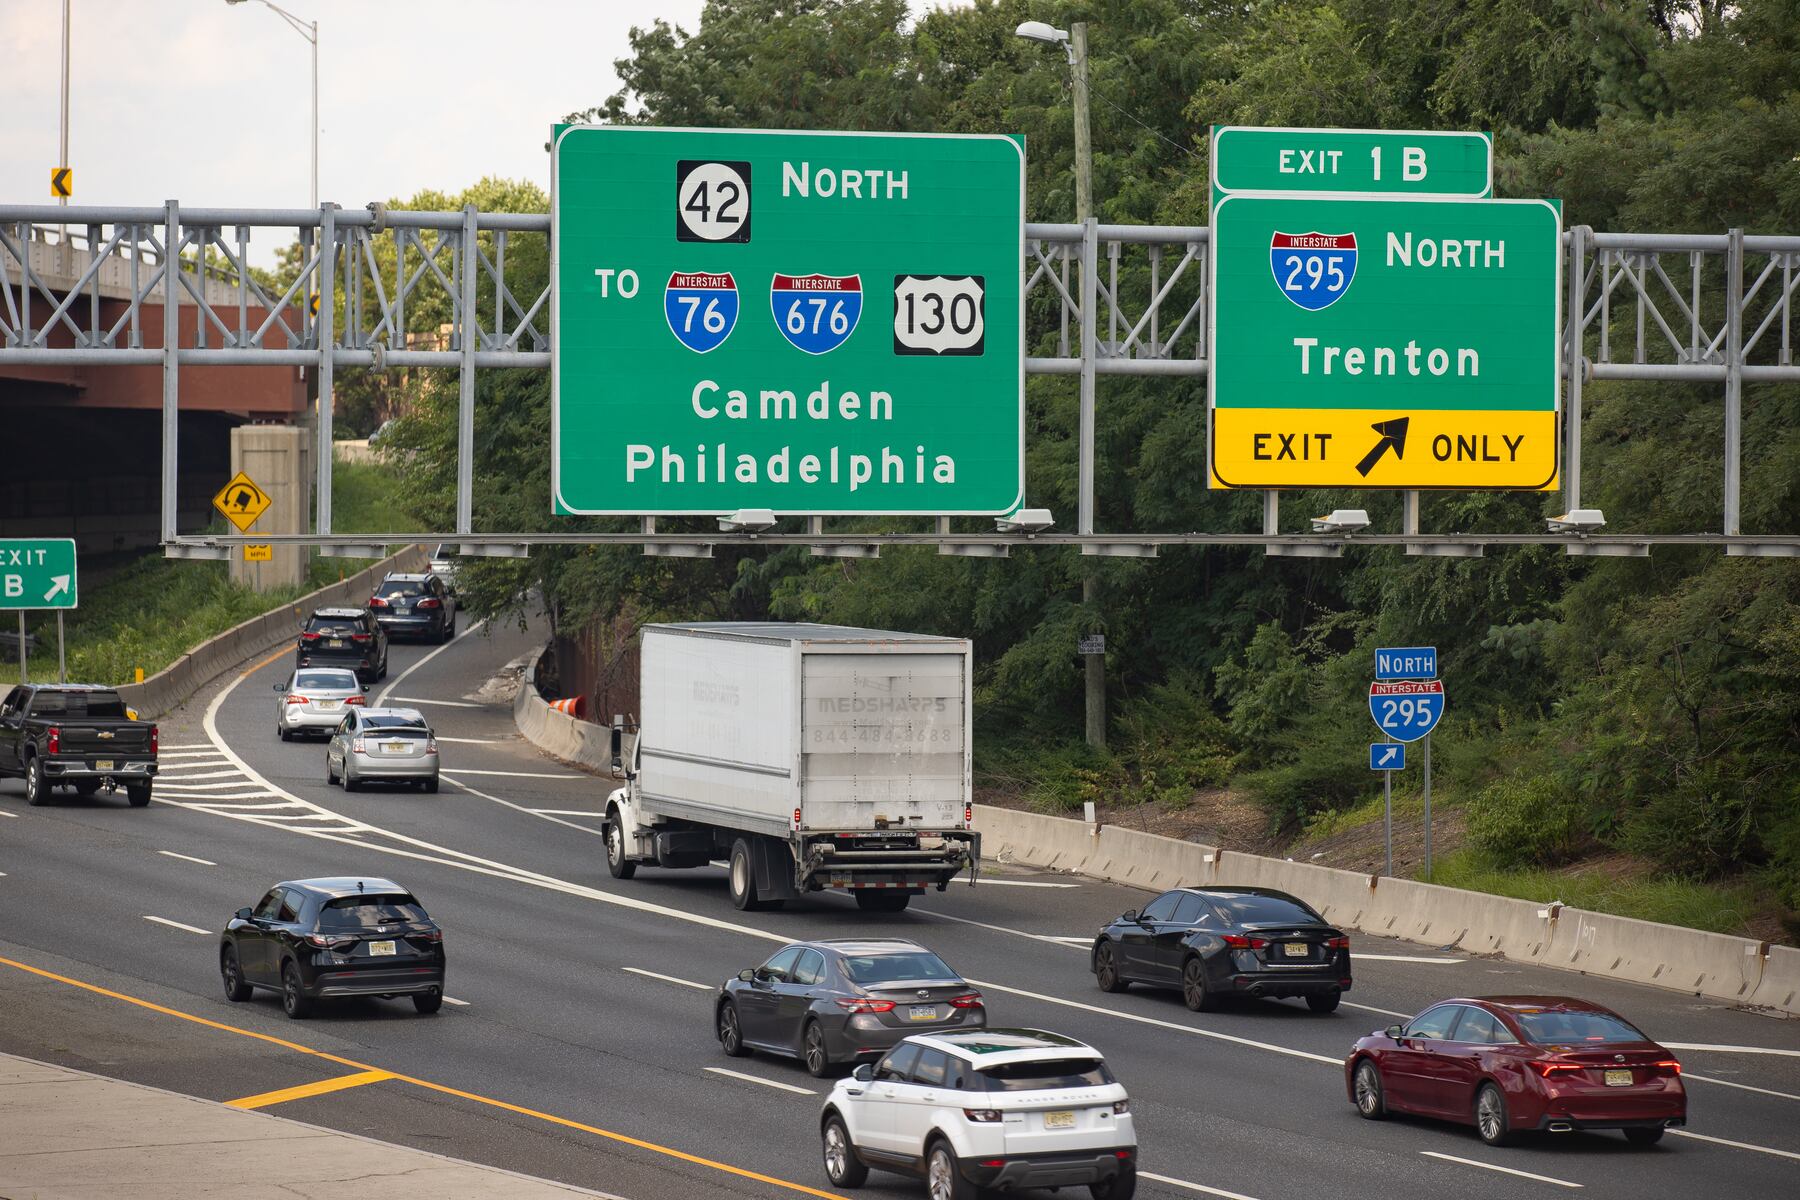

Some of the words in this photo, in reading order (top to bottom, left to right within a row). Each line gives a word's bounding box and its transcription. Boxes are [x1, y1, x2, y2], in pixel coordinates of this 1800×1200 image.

[782, 161, 909, 200] NORTH
[1279, 149, 1343, 174] EXIT
[1370, 146, 1382, 182] 1
[1402, 146, 1428, 182] B
[685, 180, 741, 223] 42
[1289, 235, 1339, 249] INTERSTATE
[1386, 231, 1506, 268] NORTH
[594, 267, 640, 300] TO
[675, 275, 728, 290] INTERSTATE
[791, 276, 842, 291] INTERSTATE
[1284, 254, 1345, 293] 295
[678, 296, 726, 335] 76
[786, 297, 849, 335] 676
[903, 292, 977, 336] 130
[1293, 337, 1480, 377] Trenton
[691, 379, 894, 421] Camden
[1253, 433, 1333, 461] EXIT
[1431, 433, 1525, 463] ONLY
[625, 442, 956, 493] Philadelphia
[1379, 654, 1433, 673] NORTH
[818, 697, 947, 713] MEDSHARPS
[1376, 683, 1437, 694] INTERSTATE
[1382, 698, 1433, 728] 295
